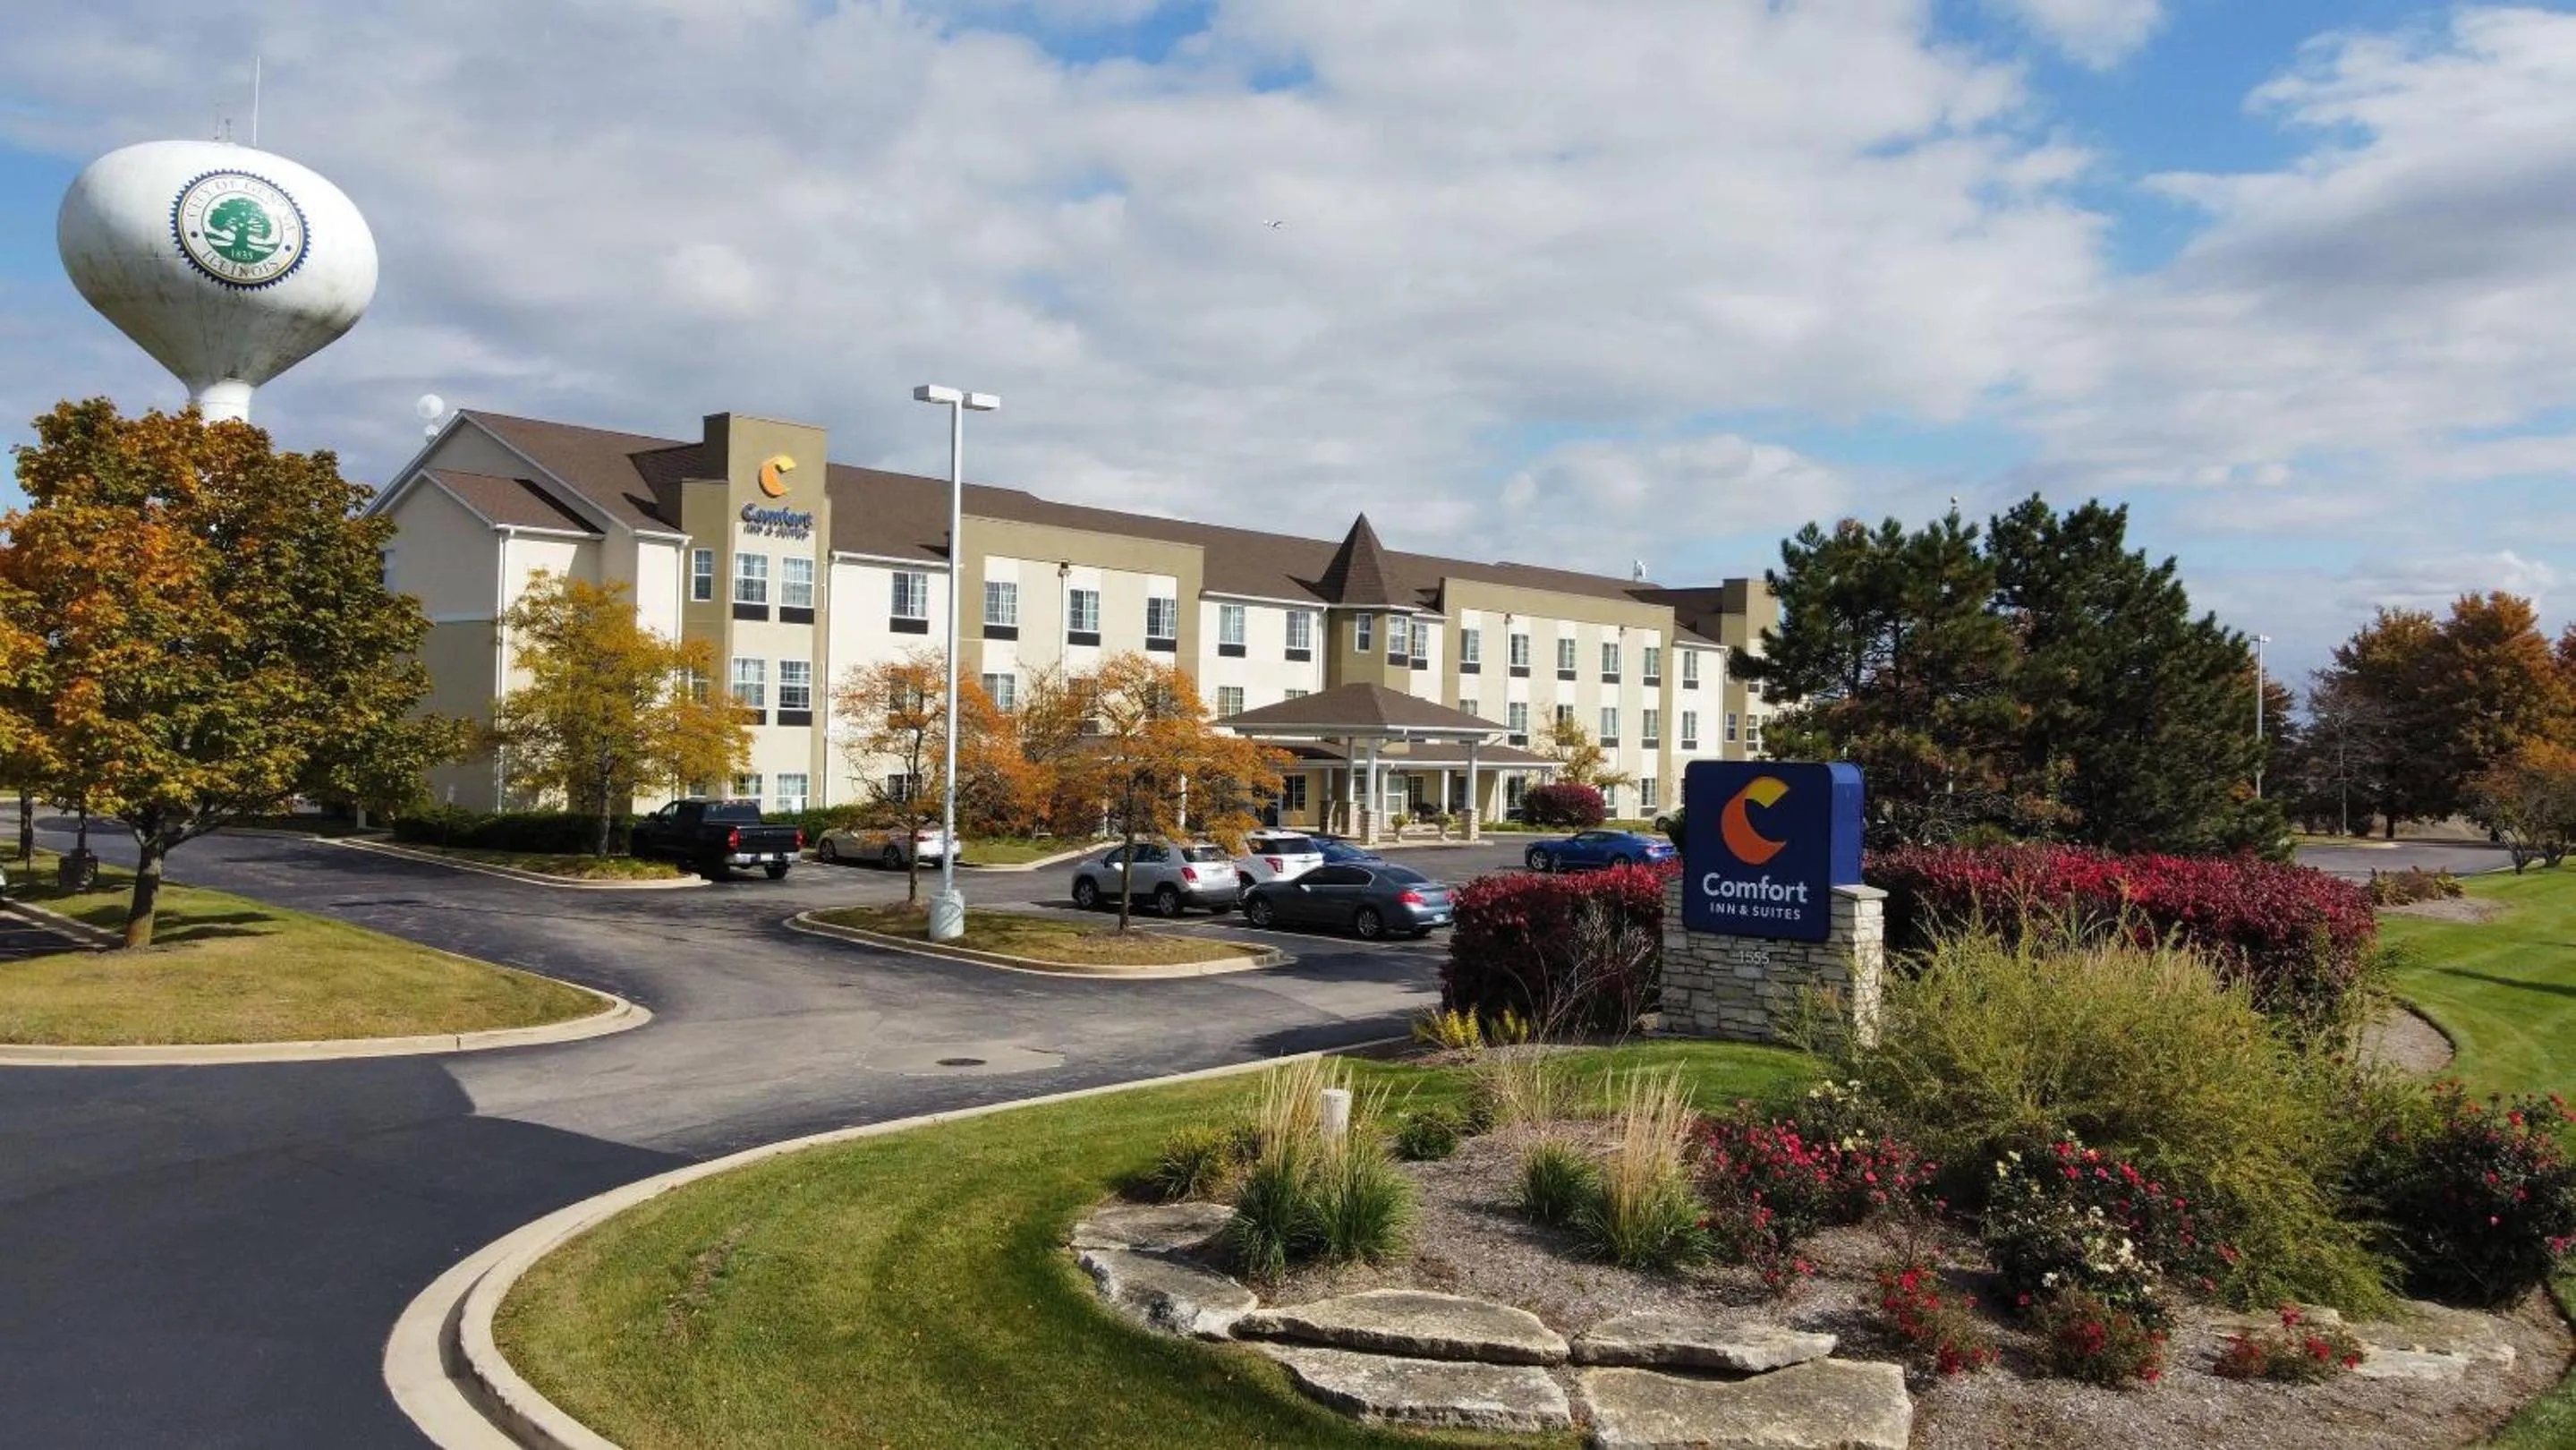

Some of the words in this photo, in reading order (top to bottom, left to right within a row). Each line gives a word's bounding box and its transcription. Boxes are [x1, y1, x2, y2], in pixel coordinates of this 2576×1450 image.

[741, 503, 813, 528] Comfort
[1703, 872, 1809, 904] Comfort
[1710, 902, 1735, 915] INN
[1739, 903, 1749, 917] &
[1752, 905, 1801, 920] SUITES
[1739, 950, 1770, 965] 1555
